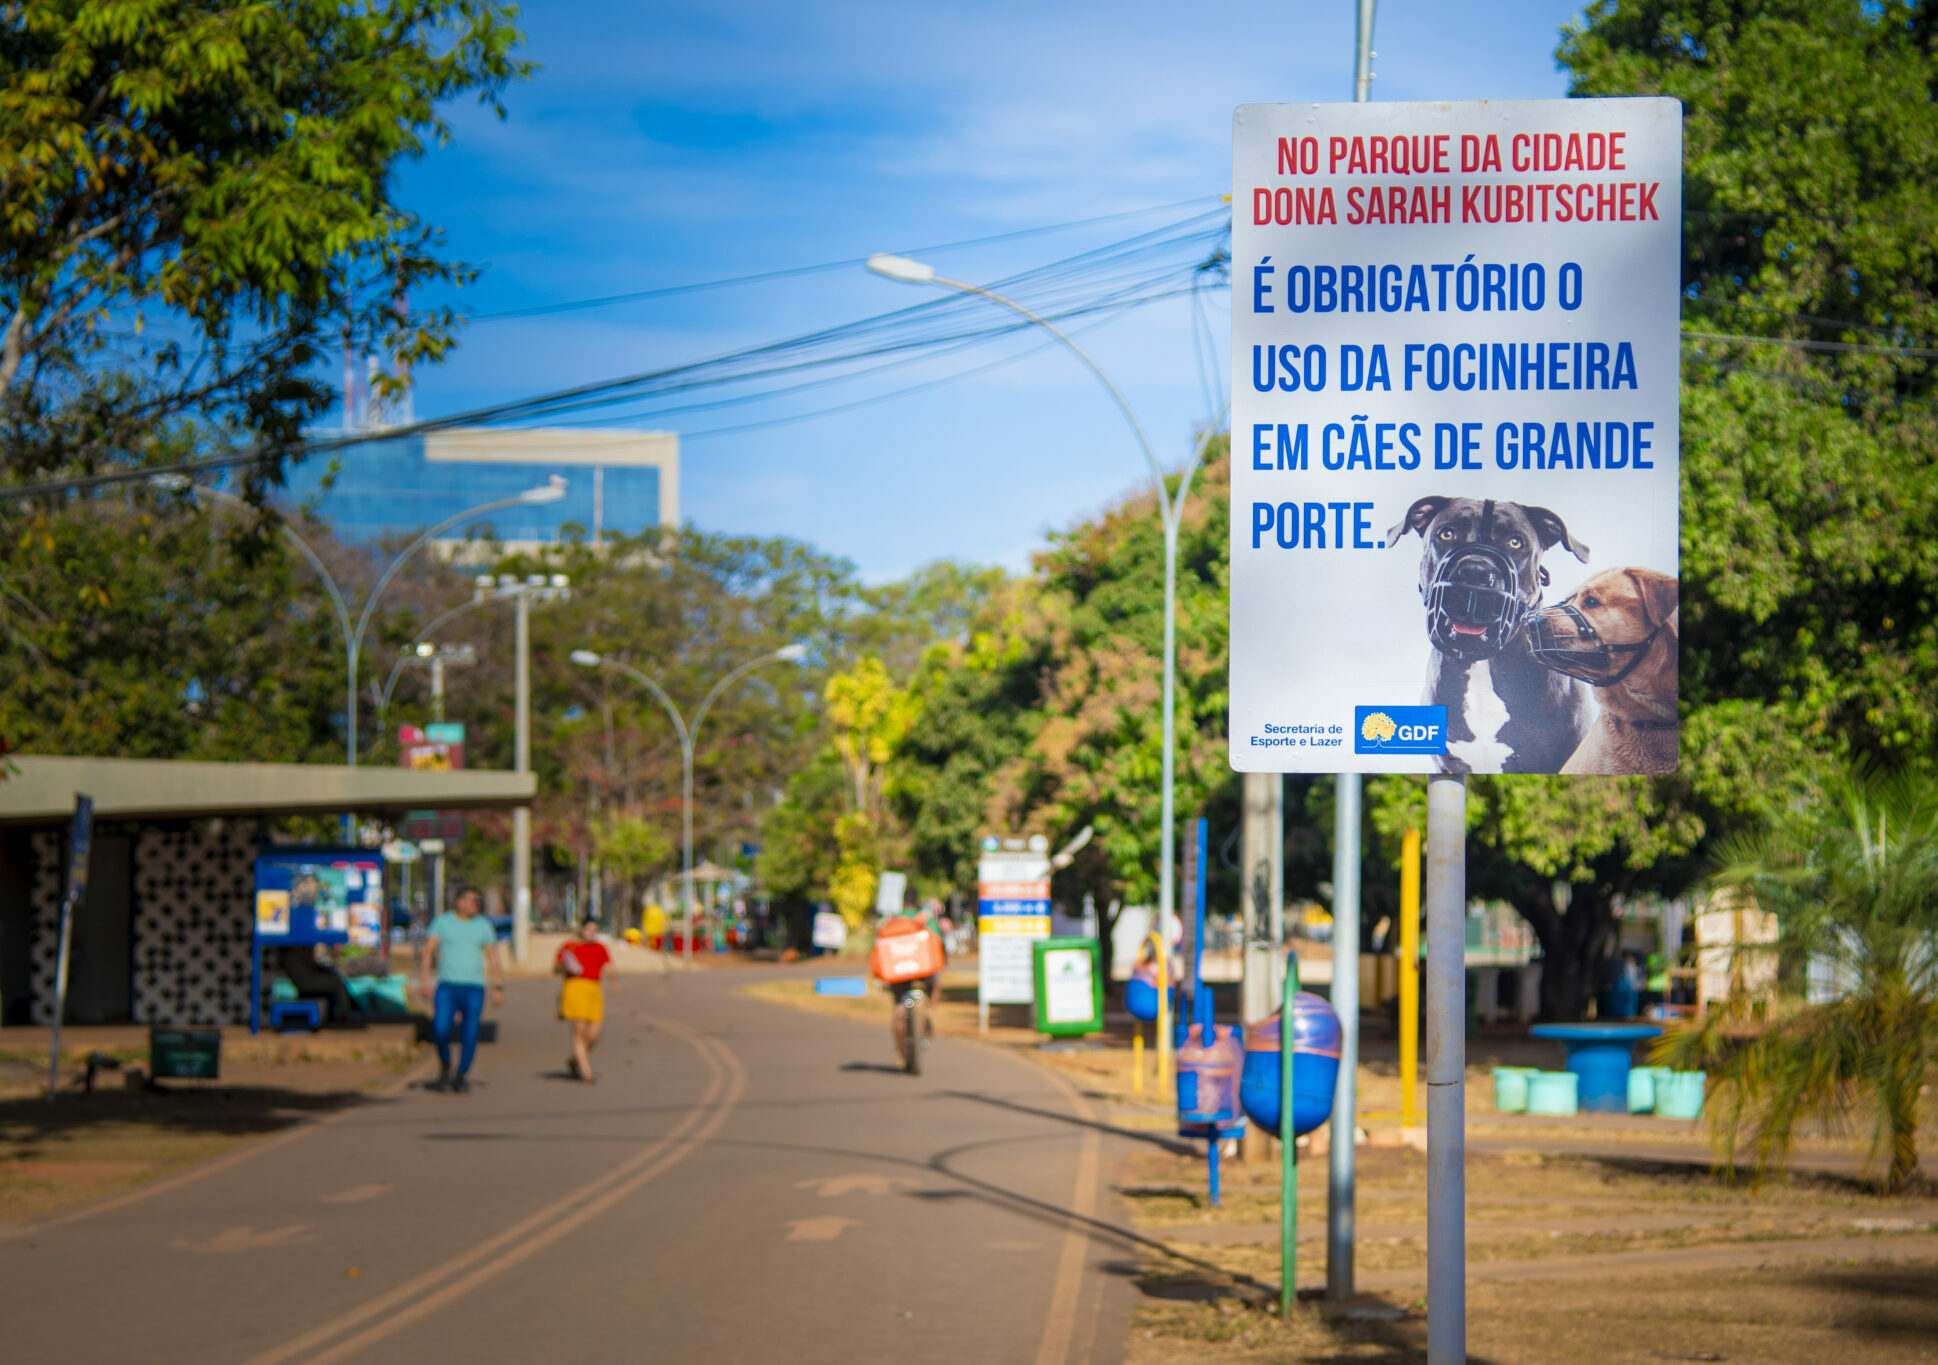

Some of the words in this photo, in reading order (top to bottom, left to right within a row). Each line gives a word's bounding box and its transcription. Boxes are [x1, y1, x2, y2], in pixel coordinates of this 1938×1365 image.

[1279, 137, 1318, 174] NO
[1330, 136, 1449, 175] PARQUE
[1462, 135, 1501, 172] DA
[1513, 133, 1625, 172] CIDADE
[1254, 188, 1336, 225] DONA
[1347, 186, 1450, 224] SARAH
[1463, 183, 1658, 223] KUBITSCHEK
[1254, 256, 1274, 313] É
[1288, 254, 1545, 313] OBRIGATÓRIO
[1559, 262, 1582, 310] O
[1253, 344, 1326, 392] USO
[1341, 345, 1391, 391] DA
[1405, 342, 1638, 391] FOCINHEIRA
[1253, 424, 1308, 470] EM
[1323, 415, 1420, 470] CÃES
[1435, 423, 1482, 469] DE
[1496, 422, 1654, 470] GRANDE
[1253, 502, 1385, 549] PORTE.
[1251, 736, 1297, 748] Esporte
[1310, 736, 1343, 747] Lazer
[1264, 724, 1325, 734] Secretaria
[1328, 724, 1343, 734] de
[1398, 725, 1440, 741] GDF
